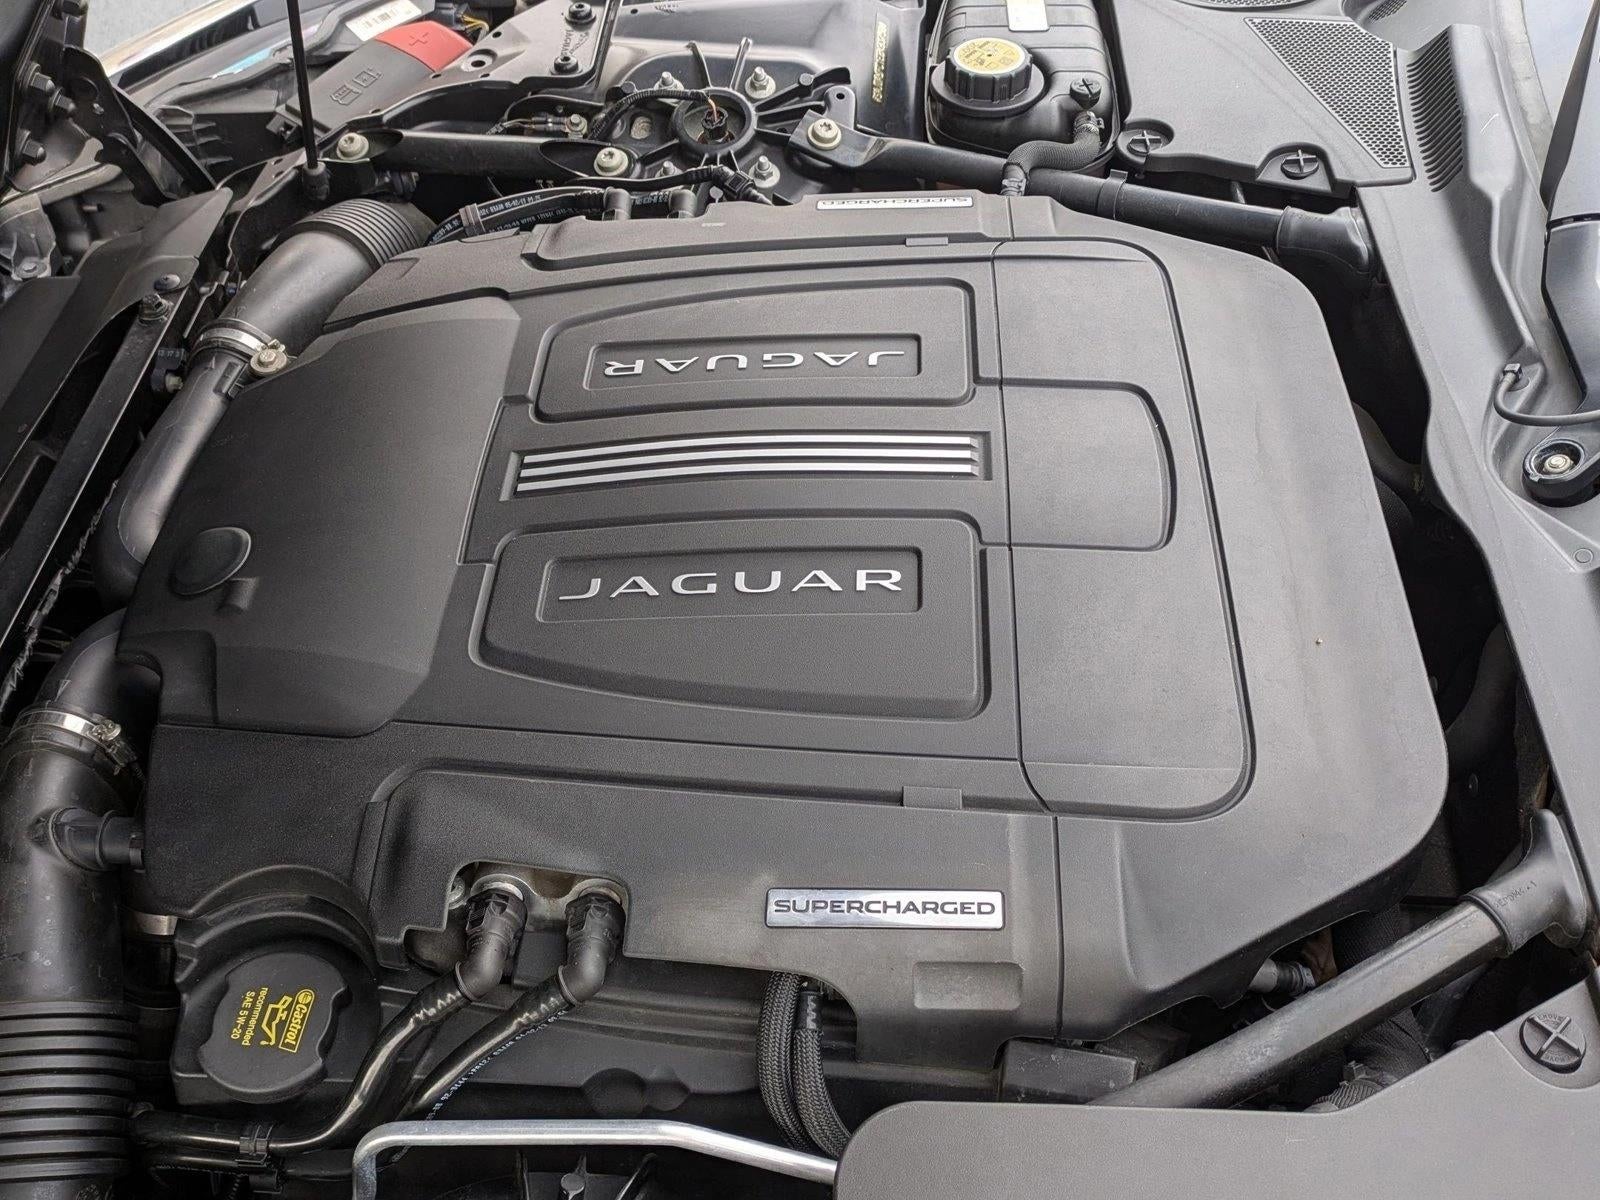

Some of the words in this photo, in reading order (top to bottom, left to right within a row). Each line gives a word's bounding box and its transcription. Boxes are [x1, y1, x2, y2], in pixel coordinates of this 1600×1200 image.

[823, 197, 968, 206] SUPERCHARGED
[604, 350, 905, 377] JAGUAR
[559, 569, 903, 600] JAGUAR
[774, 899, 996, 916] SUPERCHARGED
[241, 990, 256, 1009] SAE
[241, 986, 269, 1047] recommended
[284, 1002, 308, 1046] Castrol
